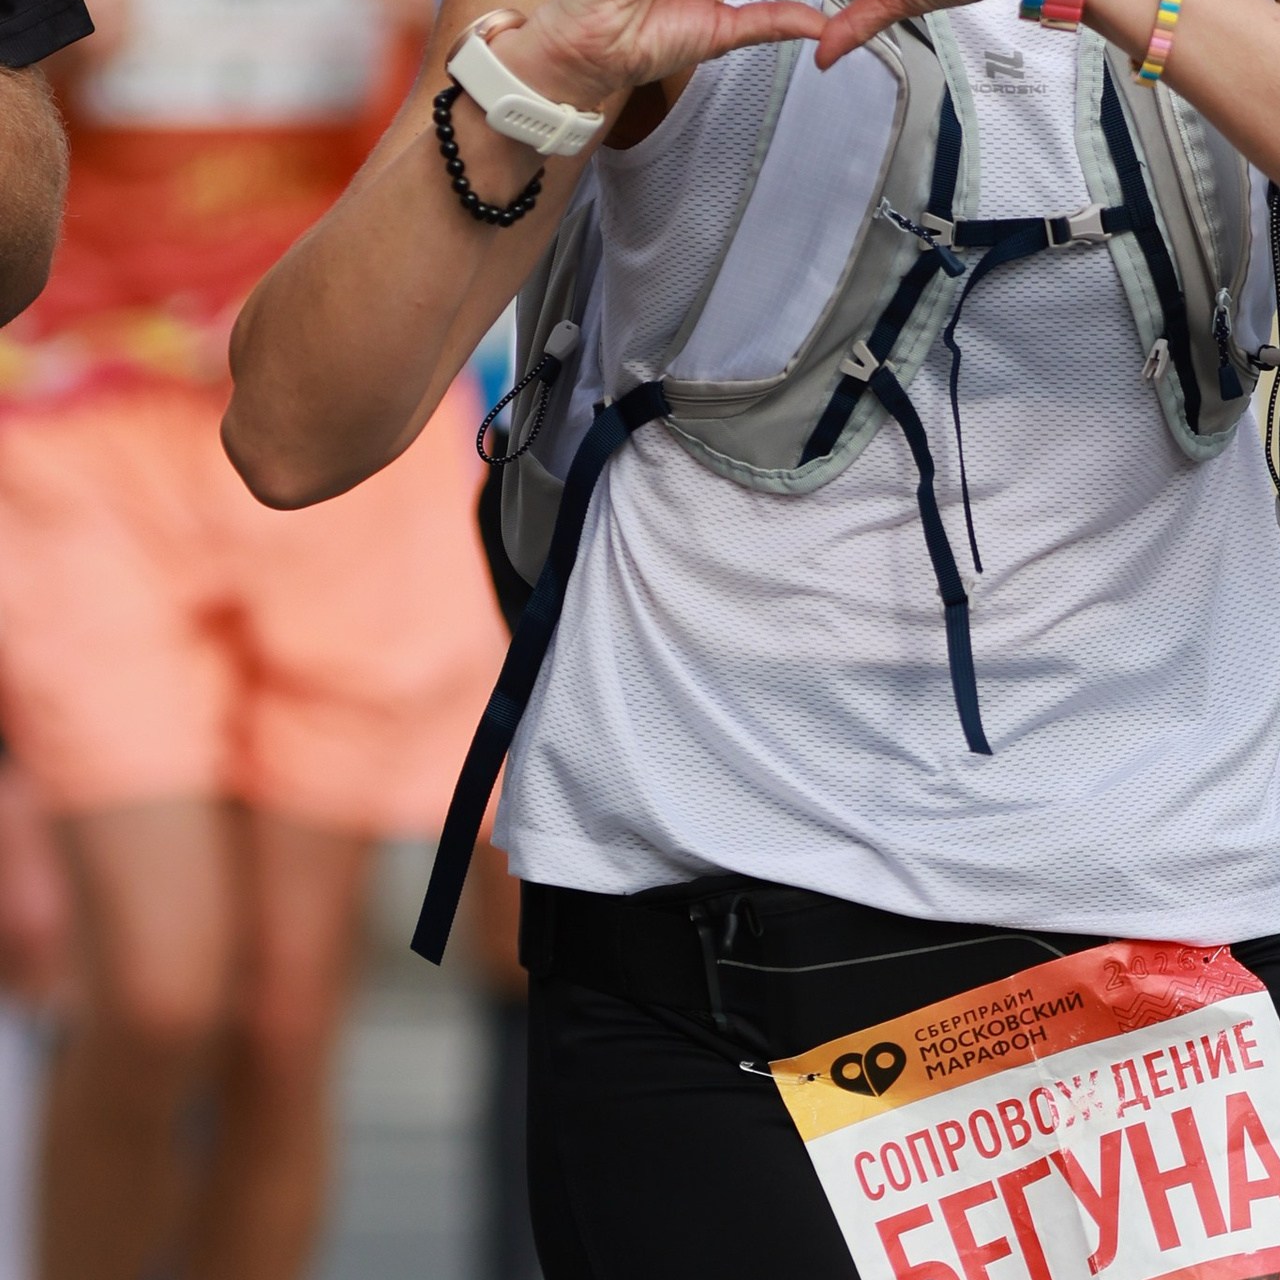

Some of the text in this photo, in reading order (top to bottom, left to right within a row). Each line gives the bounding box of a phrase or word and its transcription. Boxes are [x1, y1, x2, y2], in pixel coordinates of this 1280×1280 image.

[971, 83, 1048, 95] NORDSKI
[914, 988, 1033, 1042] СБЕРПРАЙМ
[919, 991, 1084, 1062] МОСКОВСКИЙ
[925, 1025, 1047, 1080] МАРАФОН
[853, 1020, 1264, 1201] СОПРОВОЖДЕНИЕ
